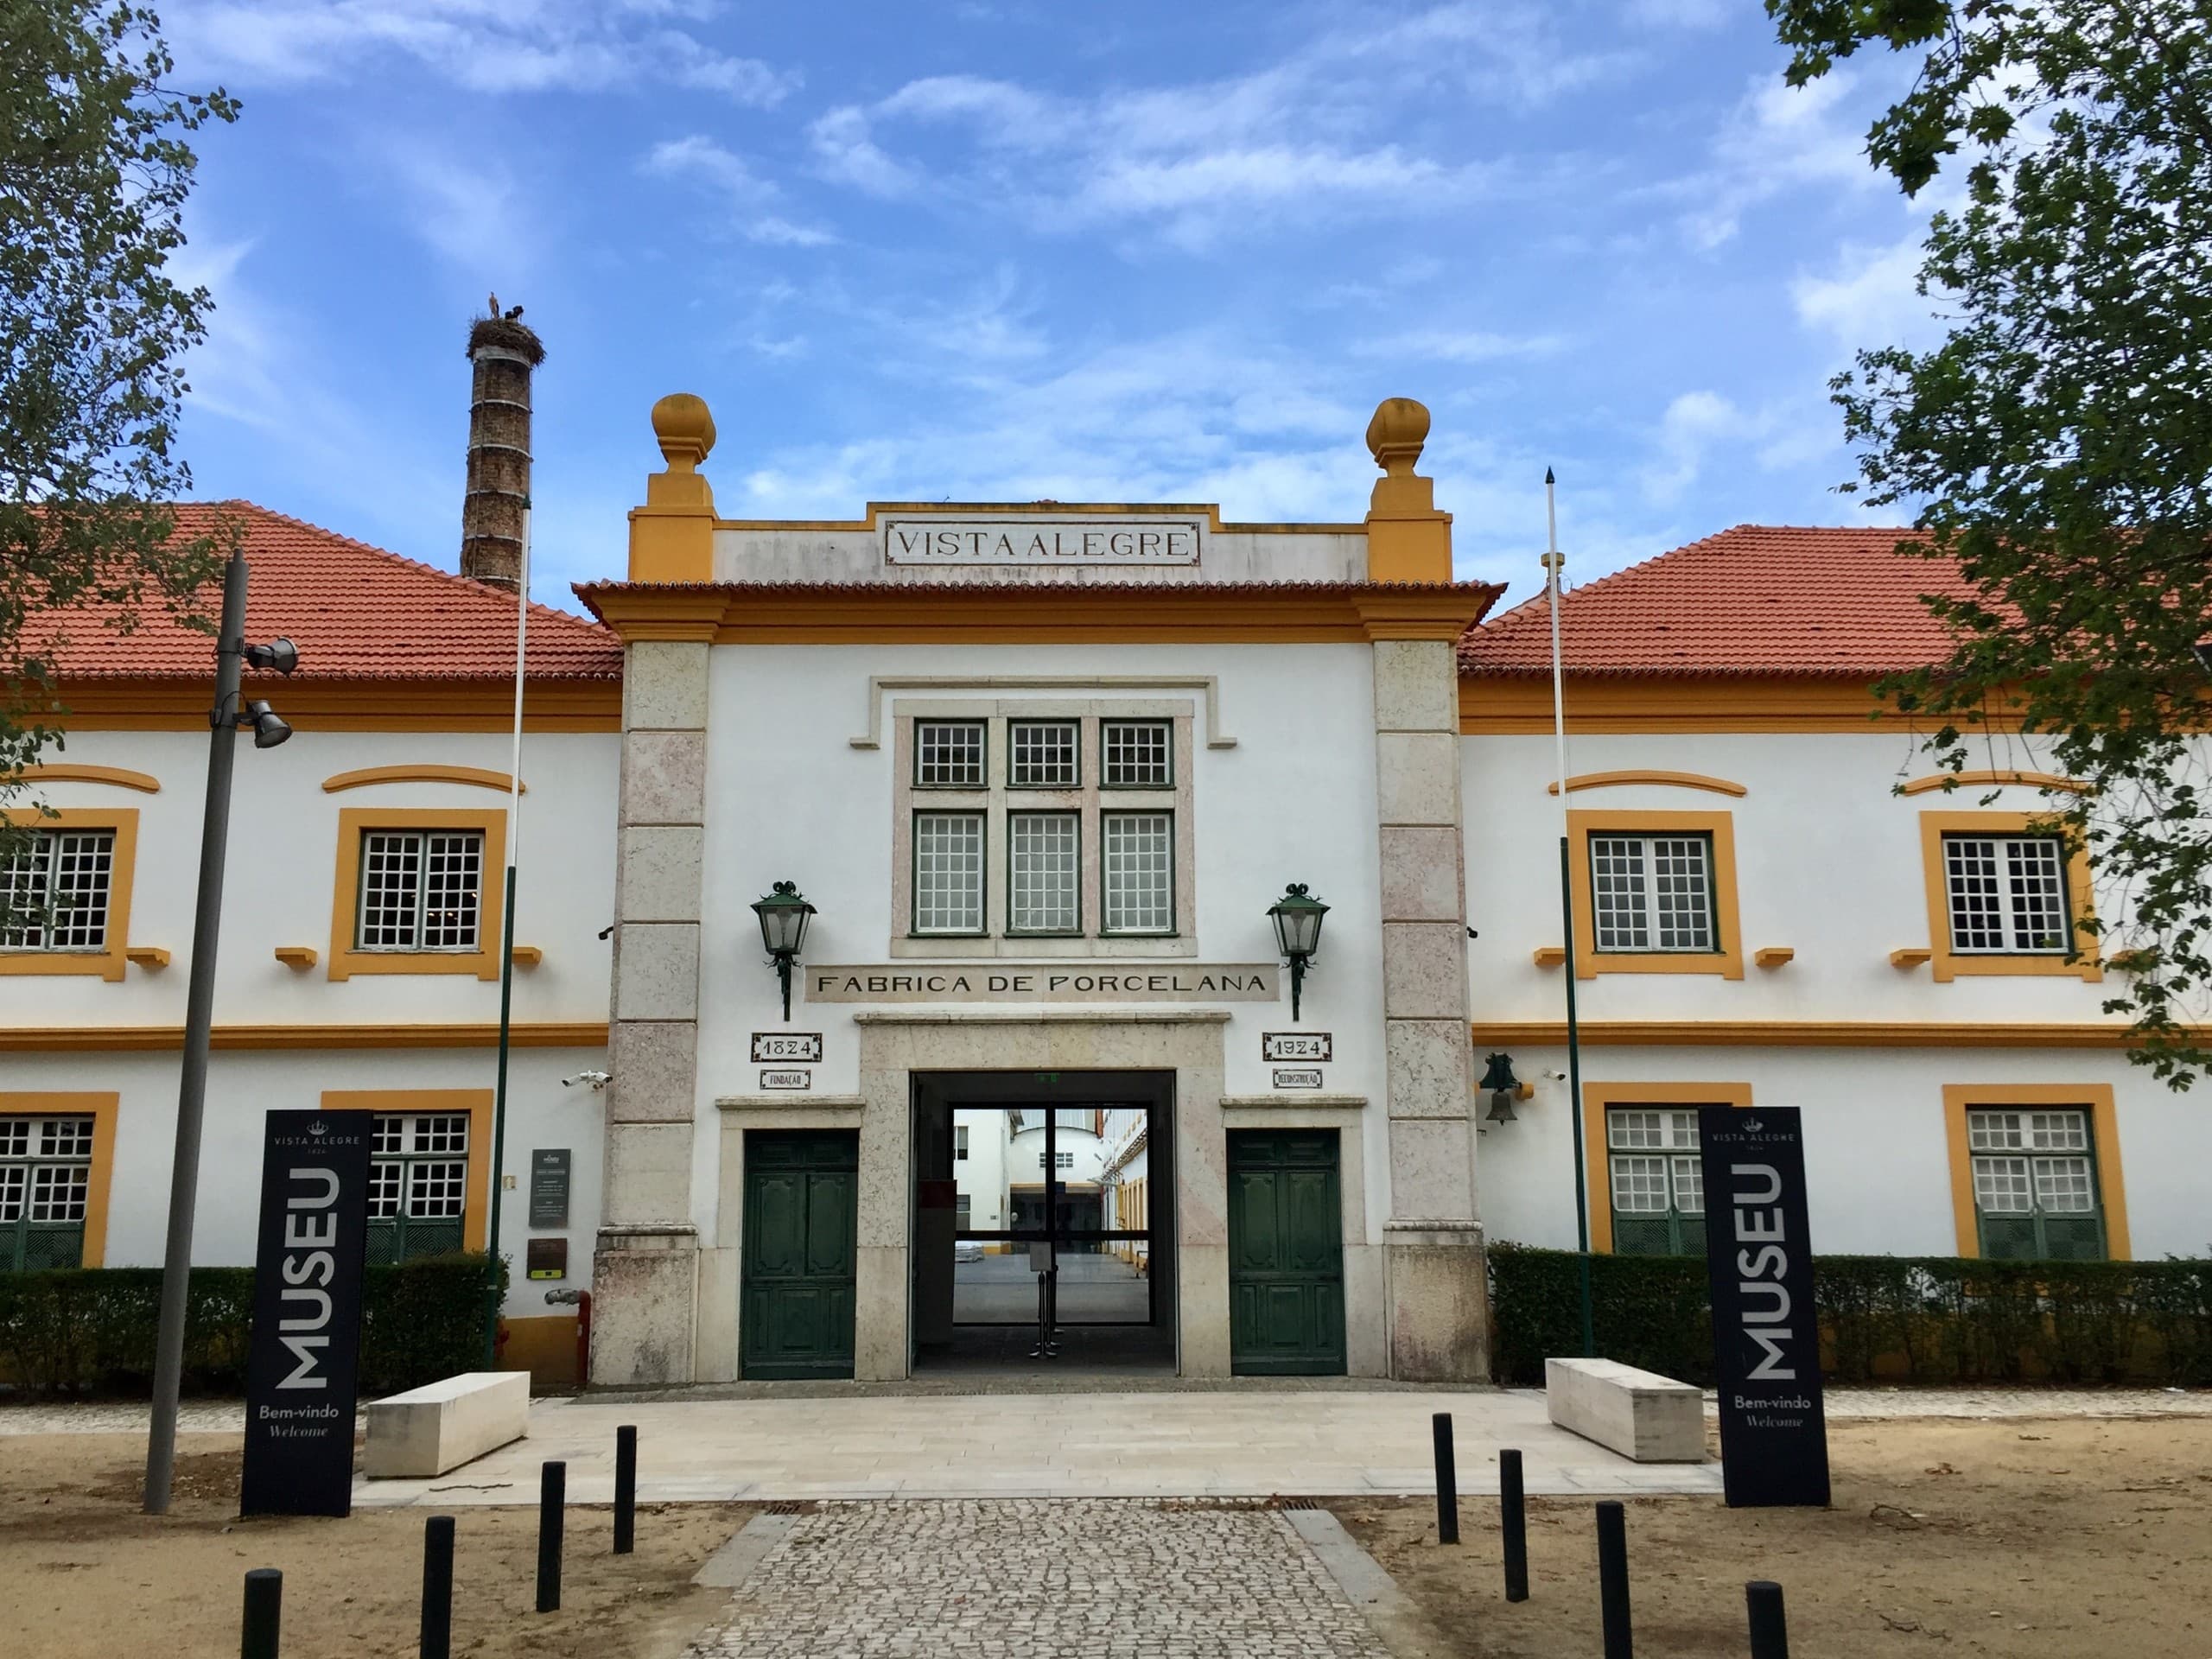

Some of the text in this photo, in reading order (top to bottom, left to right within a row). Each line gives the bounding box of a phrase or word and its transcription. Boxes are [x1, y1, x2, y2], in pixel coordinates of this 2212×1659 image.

[897, 531, 1190, 557] VISTA ALEGRE
[817, 975, 1267, 993] FABRICA DE PORCELANA
[763, 1040, 810, 1055] 1824
[1274, 1040, 1320, 1055] 1924
[314, 1136, 359, 1145] ALEGRE
[275, 1167, 340, 1389] MUSEU
[1731, 1164, 1796, 1380] MUSEU
[1734, 1395, 1812, 1409] Bem-vindo
[259, 1403, 340, 1420] Bem-vindo
[1746, 1415, 1803, 1427] Welcome
[270, 1425, 328, 1437] Welcome
